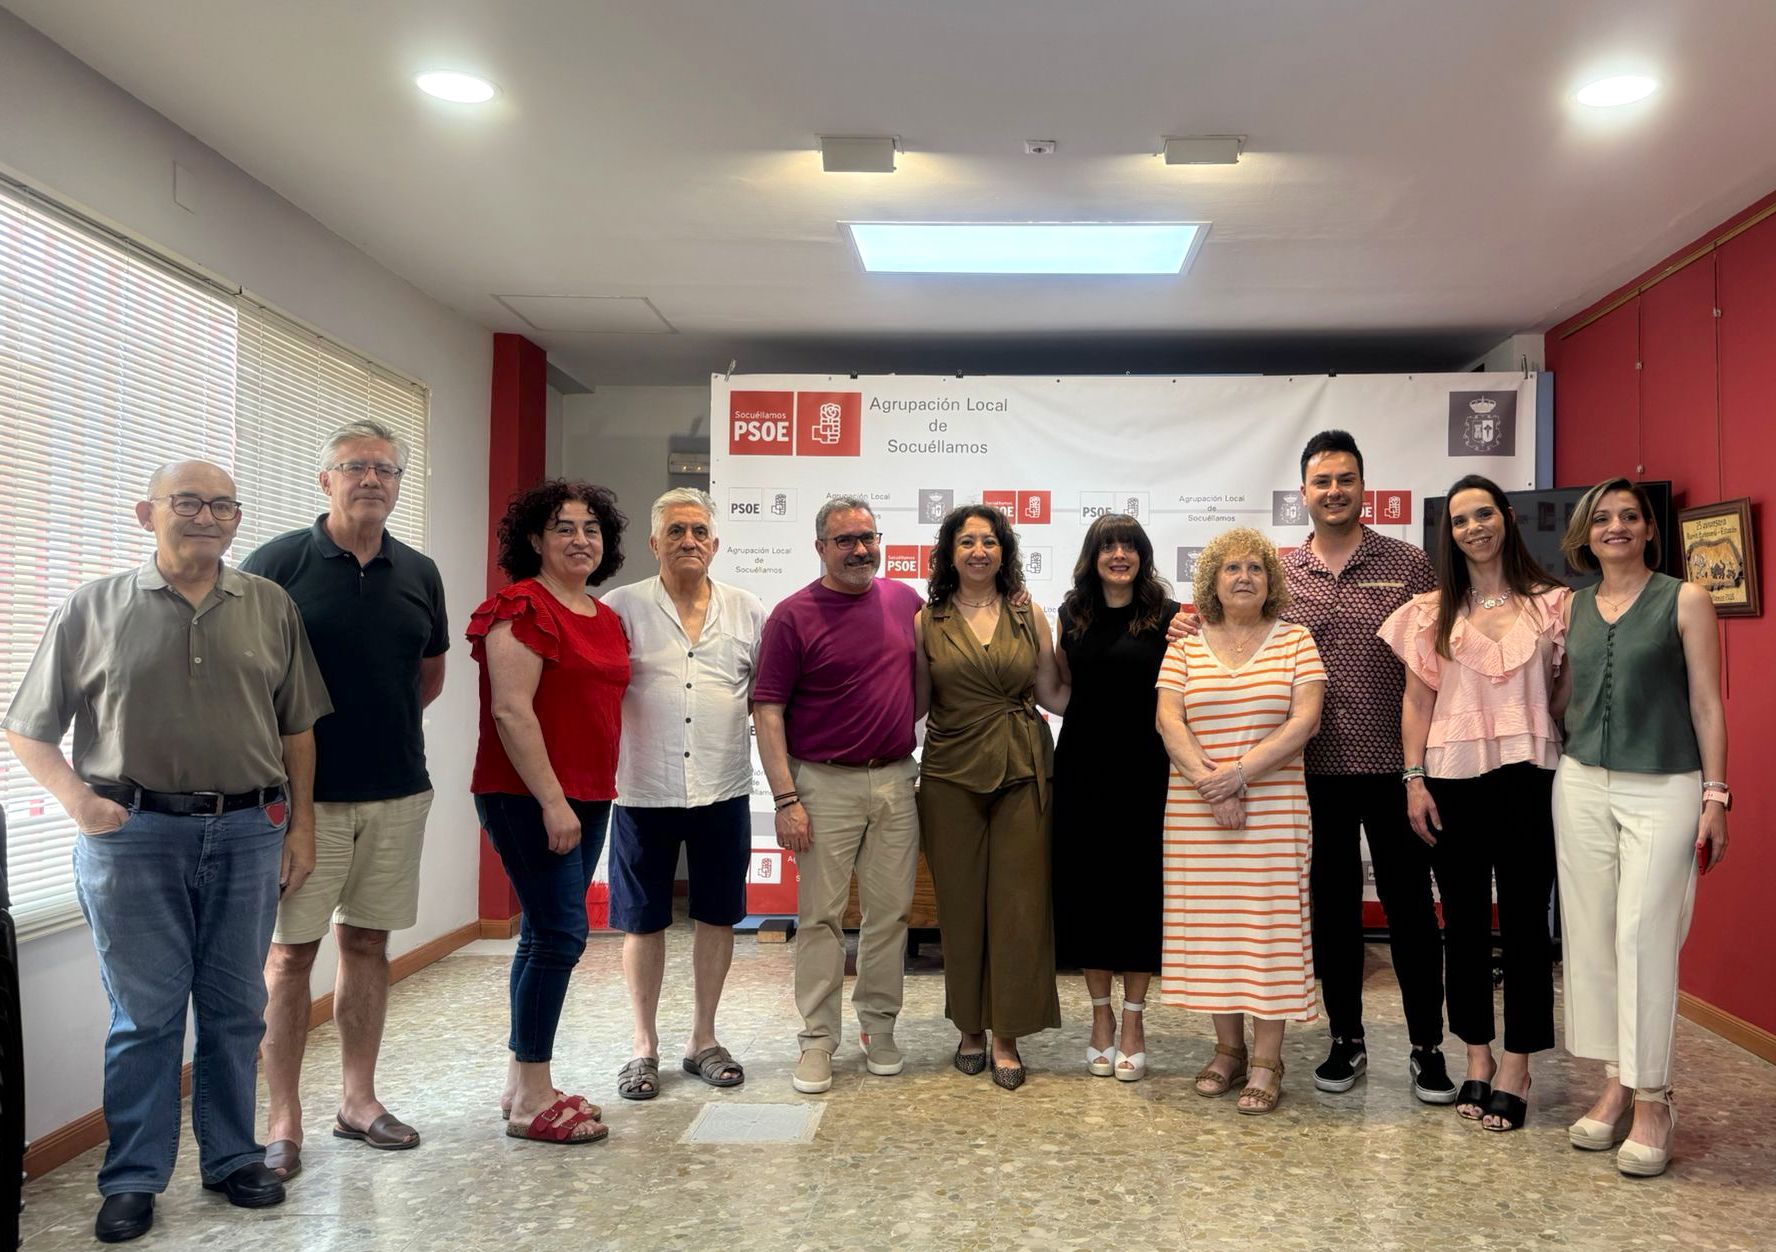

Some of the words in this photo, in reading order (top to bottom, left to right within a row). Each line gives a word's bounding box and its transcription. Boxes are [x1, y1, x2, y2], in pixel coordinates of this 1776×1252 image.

[869, 397, 960, 414] Agrupación
[966, 398, 1008, 412] Local
[735, 410, 787, 420] Socuéllamos
[928, 419, 948, 432] de
[734, 421, 789, 442] PSOE
[887, 439, 988, 454] Socuéllamos
[1179, 495, 1222, 504] Agrupación
[1224, 495, 1245, 503] Local
[731, 503, 760, 514] PSOE
[1187, 514, 1236, 522] Socuéllamos
[727, 546, 769, 555] Agrupación
[772, 547, 792, 555] Local
[735, 565, 782, 574] Socuéllamos
[887, 560, 917, 572] PSOE
